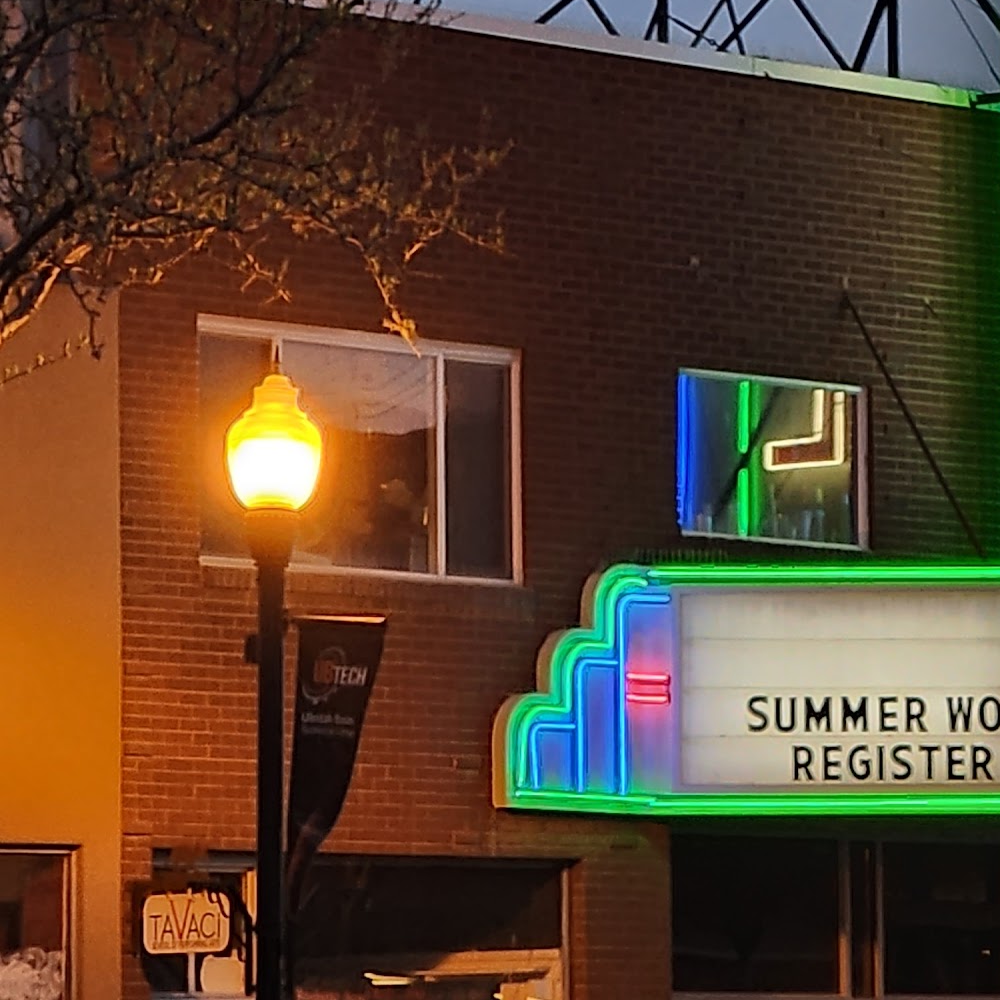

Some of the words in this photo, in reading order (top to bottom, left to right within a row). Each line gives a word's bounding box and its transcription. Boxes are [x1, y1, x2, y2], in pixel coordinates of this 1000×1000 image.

[748, 695, 928, 733] SUMMER
[793, 744, 994, 781] REGISTER
[149, 898, 222, 941] TAVACI
